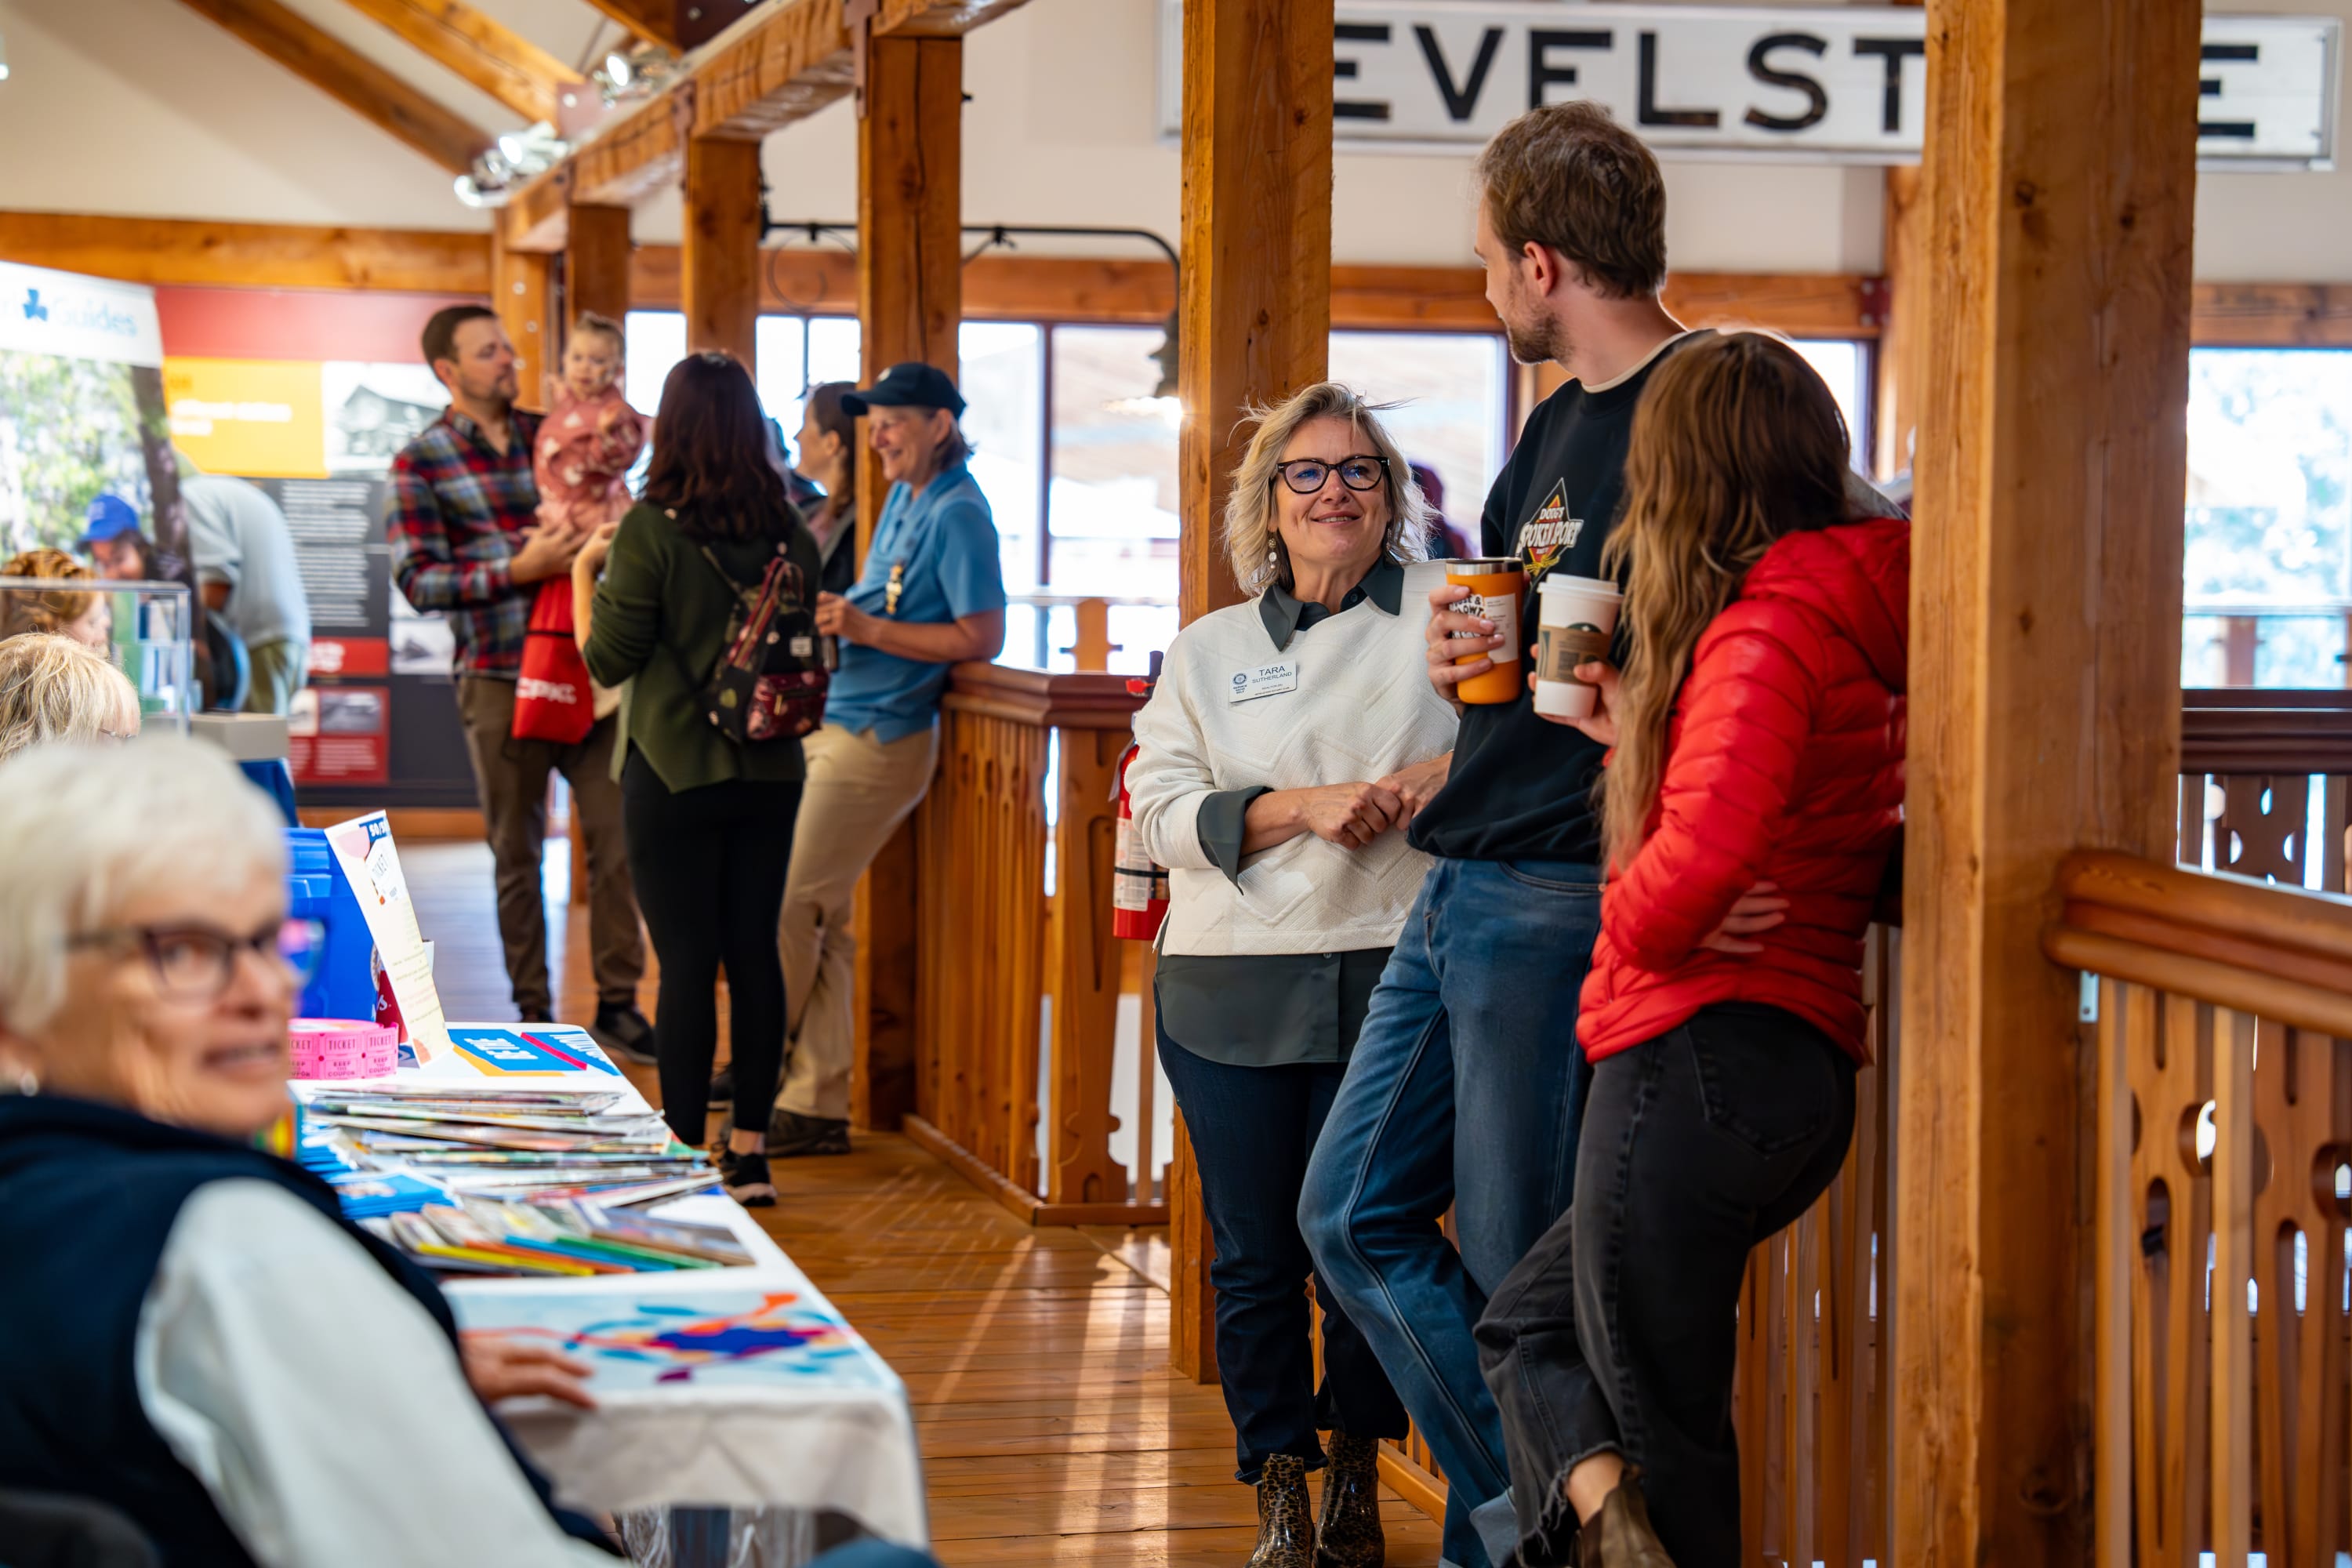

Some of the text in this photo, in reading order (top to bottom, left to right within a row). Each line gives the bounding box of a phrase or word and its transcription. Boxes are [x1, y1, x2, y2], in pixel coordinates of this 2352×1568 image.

[1259, 666, 1286, 677] TARA
[1252, 672, 1292, 684] SUTHERLAND
[289, 1040, 311, 1050] CKET
[328, 1039, 356, 1050] TICKET
[369, 1035, 391, 1047] TICKET
